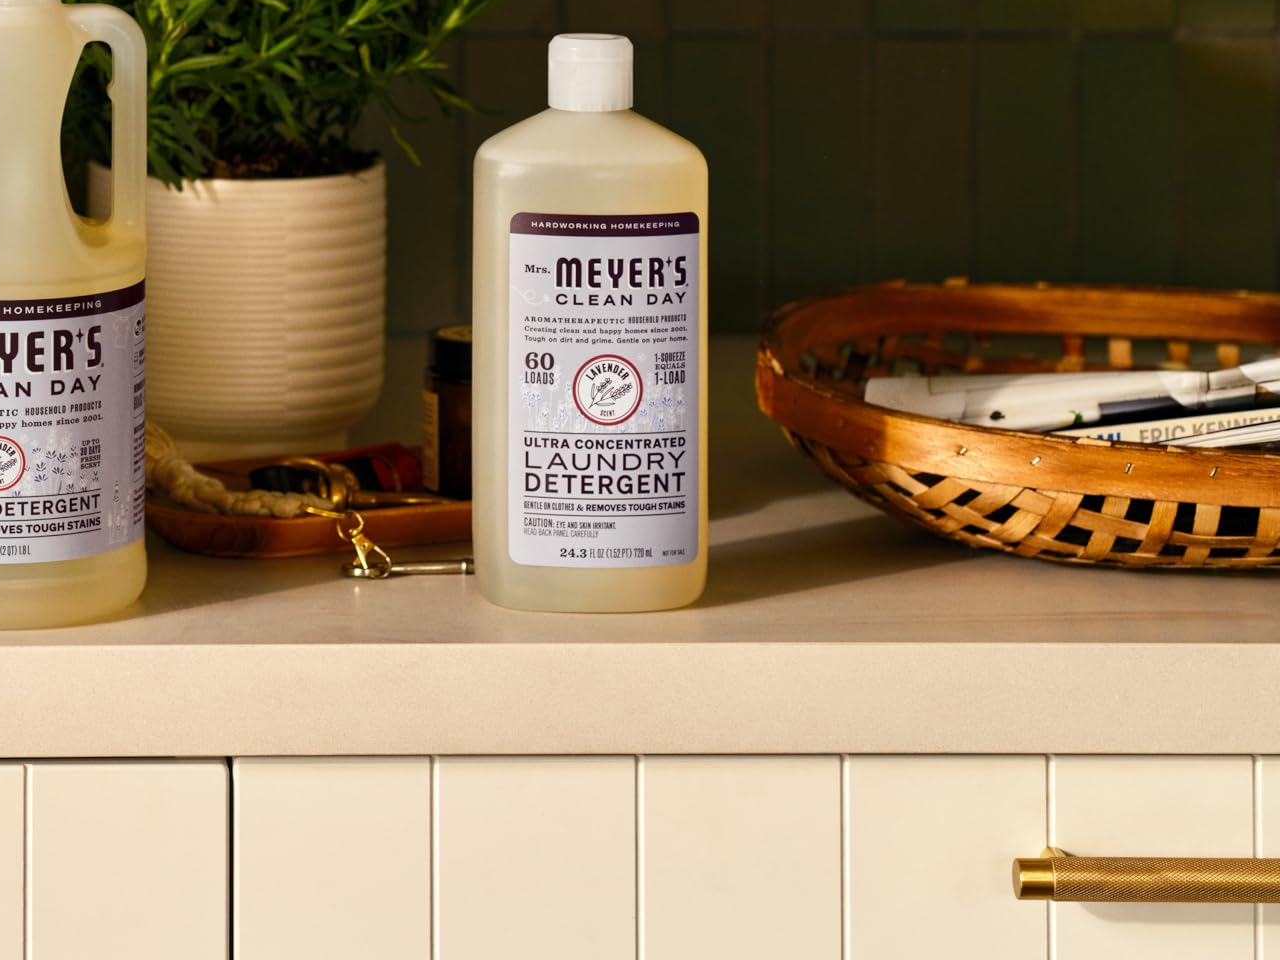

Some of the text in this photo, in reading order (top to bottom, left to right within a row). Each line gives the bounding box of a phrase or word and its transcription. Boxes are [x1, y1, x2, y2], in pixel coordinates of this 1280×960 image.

[531, 221, 680, 230] HARDWORKING HOMEKEEPING
[525, 265, 551, 274] Mrs.
[556, 292, 686, 306] CLEAN DAY
[3, 300, 102, 314] HOMEKEEPING
[524, 316, 624, 324] AROMATHERAPEUTIC
[524, 326, 556, 334] Creating
[599, 327, 621, 335] happy
[525, 336, 546, 344] Tough
[592, 337, 613, 345] grime.
[525, 352, 555, 371] 60
[655, 351, 685, 363] 1-SQUEEZE
[585, 363, 630, 381] LAVENDER
[655, 362, 685, 370] EQUALS
[525, 371, 555, 385] LOADS
[655, 370, 685, 385] 1-LOAD
[51, 375, 101, 396] DAY
[25, 405, 66, 416] HOUSEHOLD
[70, 401, 102, 412] PRODUCTS
[600, 409, 615, 417] SCENT
[83, 414, 103, 422] 2001.
[1139, 425, 1185, 442] ERIC
[524, 437, 686, 450] ULTRA CONCENTRATED
[81, 461, 101, 469] SCENT
[525, 450, 686, 471] LAUNDRY
[525, 472, 685, 495] DETERGENT
[524, 501, 543, 510] GENTLE
[544, 502, 550, 510] ON
[552, 503, 575, 511] CLOTHES
[586, 504, 626, 512] REMOVES
[628, 503, 657, 511] TOUGH
[658, 501, 685, 510] STAINS
[26, 523, 65, 533] TOUGH
[67, 517, 101, 529] STAINS
[524, 517, 555, 528] CAUTION:
[553, 529, 569, 537] PANEL
[571, 530, 598, 538] CAREFULLY
[560, 548, 587, 558] 24.3
[590, 548, 595, 558] FL
